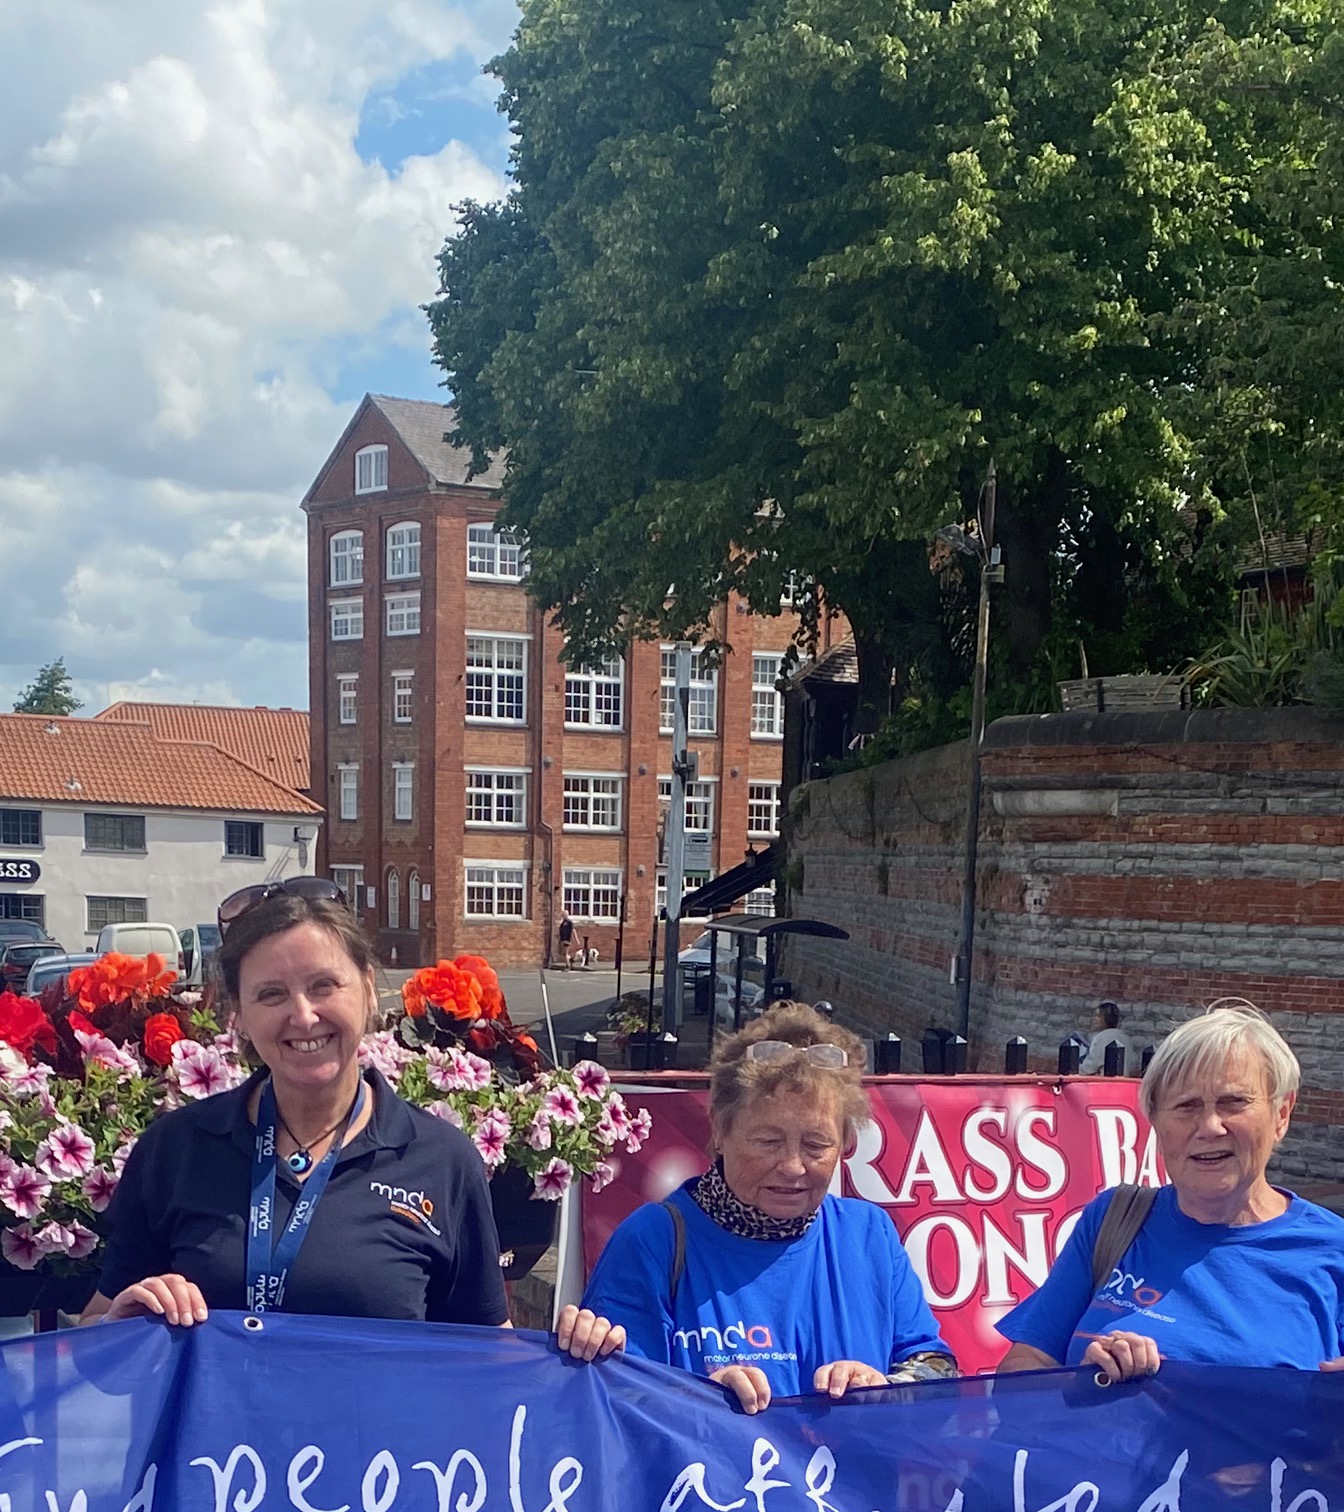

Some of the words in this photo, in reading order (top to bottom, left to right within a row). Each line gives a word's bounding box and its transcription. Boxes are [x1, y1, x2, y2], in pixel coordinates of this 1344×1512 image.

[826, 1107, 1068, 1205] RASS
[1088, 1107, 1173, 1193] BA
[370, 1181, 434, 1217] mnda
[673, 1321, 773, 1353] mnda
[731, 1351, 770, 1363] neurone
